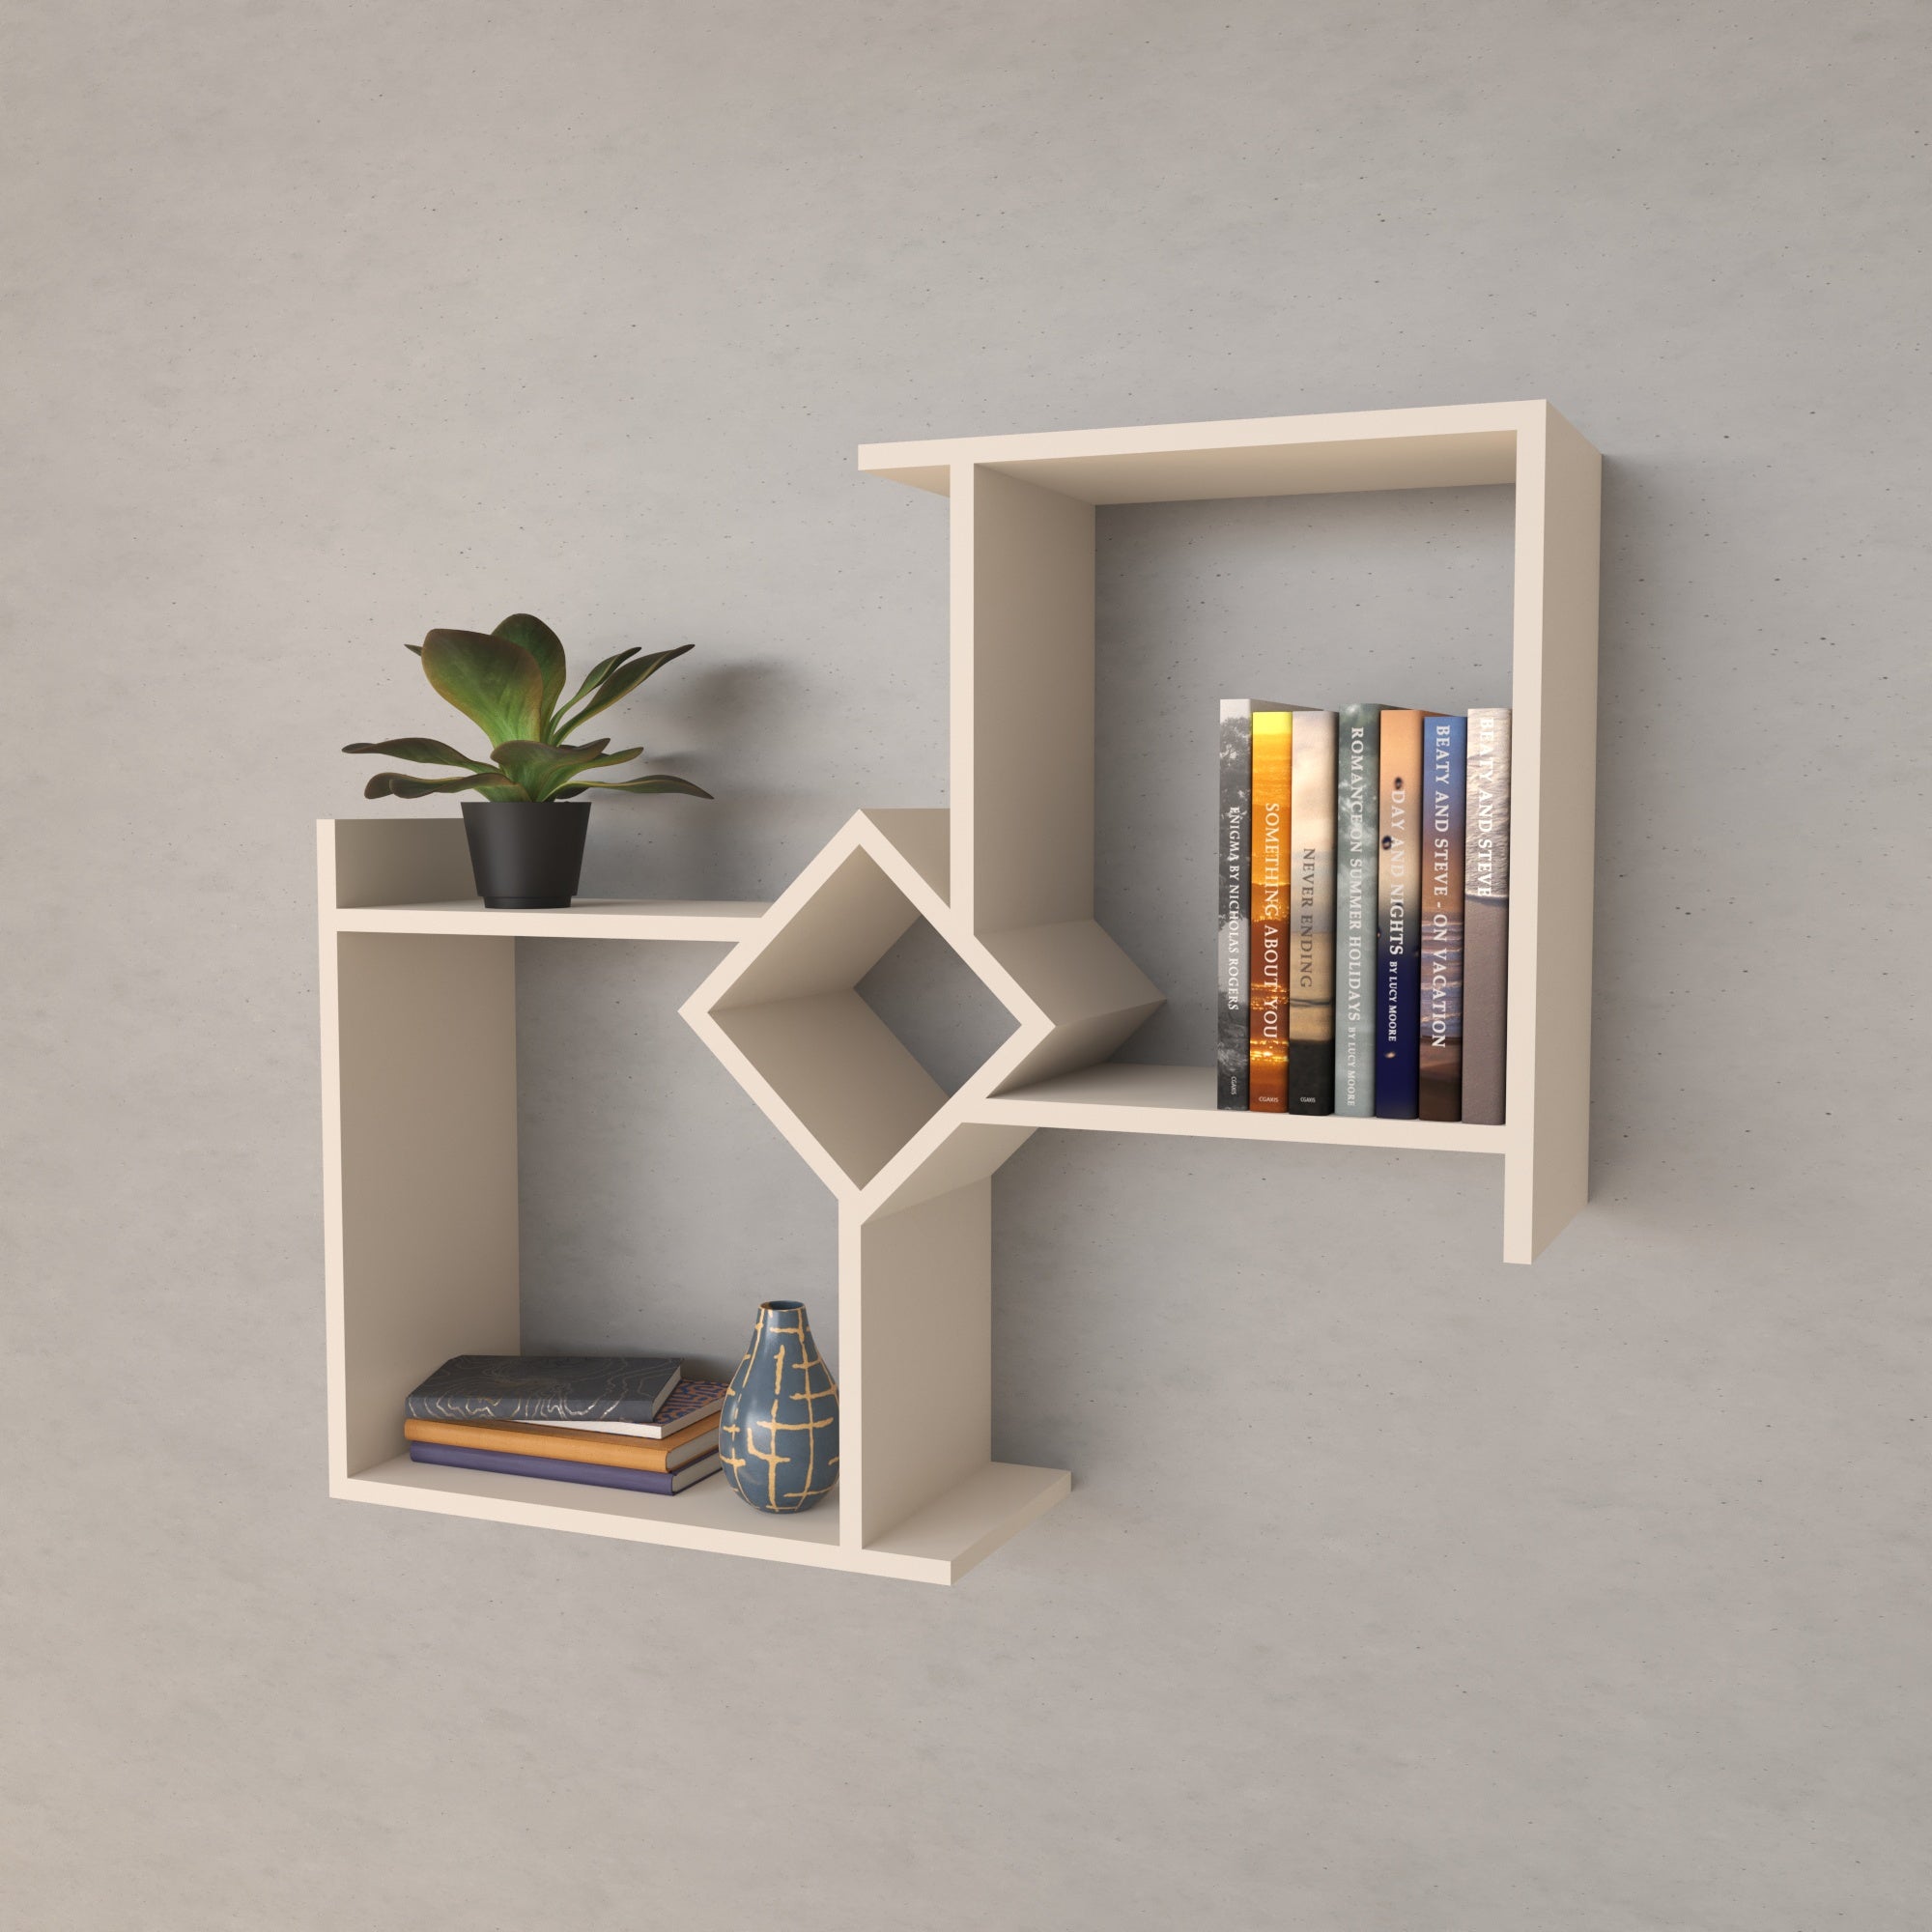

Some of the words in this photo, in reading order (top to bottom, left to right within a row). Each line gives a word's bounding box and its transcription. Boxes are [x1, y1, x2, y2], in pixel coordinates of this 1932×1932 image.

[1435, 724, 1450, 784] BEATY
[1479, 718, 1494, 782] BEATY
[1230, 807, 1240, 862] ENIGMA
[1391, 790, 1405, 830] DAY
[1435, 791, 1449, 835] AND
[1478, 789, 1492, 833] AND
[1230, 865, 1239, 882] BY
[1264, 803, 1279, 918] SOMETHING
[1301, 848, 1316, 908] NEVER
[1391, 837, 1405, 877] AND
[1435, 838, 1448, 896] STEVE
[1477, 838, 1492, 896] STEVE
[1229, 885, 1239, 954] NICHOLAS
[1350, 858, 1362, 930] SUMMER
[1390, 883, 1404, 955] NIGHTS
[1300, 914, 1313, 988] ENDING
[1433, 913, 1448, 942] ON
[1228, 957, 1238, 1010] ROGERS
[1264, 924, 1279, 991] ABOUT
[1349, 936, 1361, 1021] HOLIDAYS
[1390, 961, 1398, 975] BY
[1264, 997, 1278, 1039] YOU
[1389, 976, 1398, 1003] LUCY
[1432, 948, 1447, 1047] VACATION
[1349, 1027, 1355, 1041] BY
